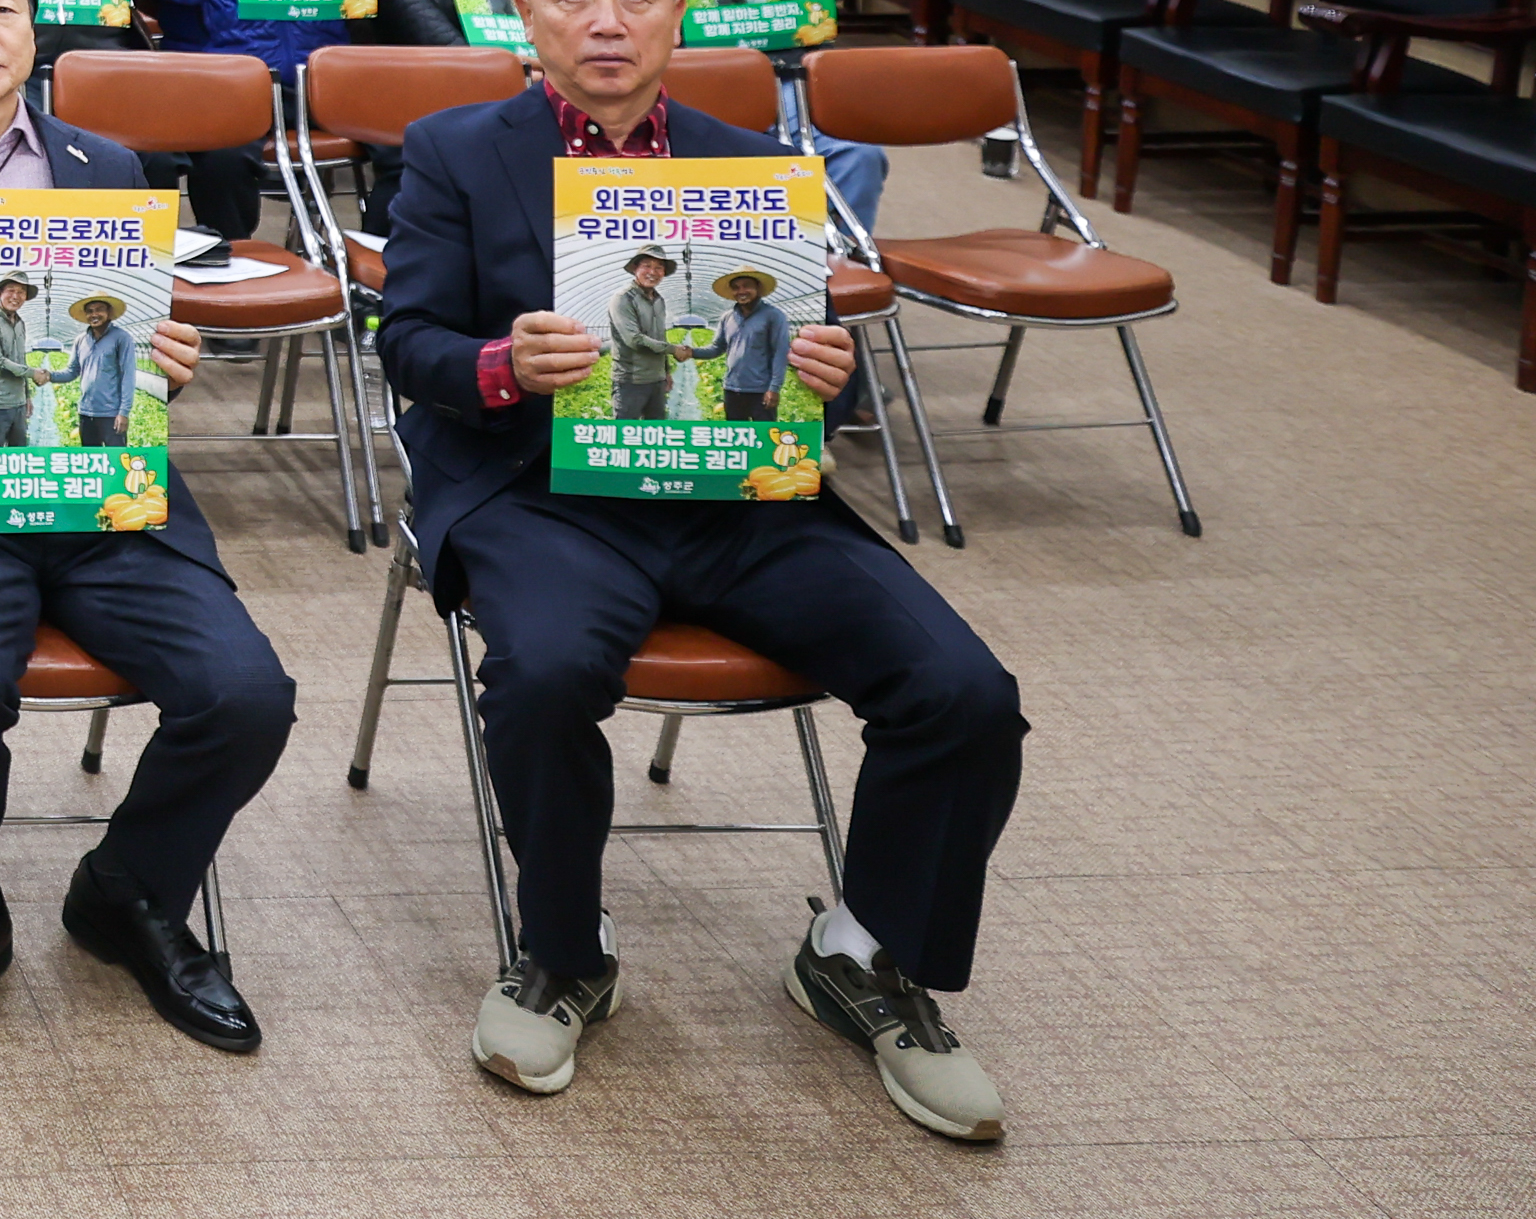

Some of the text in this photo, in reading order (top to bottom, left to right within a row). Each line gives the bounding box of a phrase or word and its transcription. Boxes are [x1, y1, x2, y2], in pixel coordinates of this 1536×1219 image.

[595, 189, 786, 213] 외국인 근로자도
[46, 220, 141, 243] 근로자도
[577, 217, 804, 241] 우리의 가족입니다.
[28, 246, 155, 269] 가족입니다.
[574, 424, 762, 448] 함께 일하는 동반자,
[51, 453, 115, 475] 동반자,
[587, 448, 747, 470] 함께 지키는 권리
[0, 479, 59, 499] 지키는
[64, 478, 102, 499] 권리
